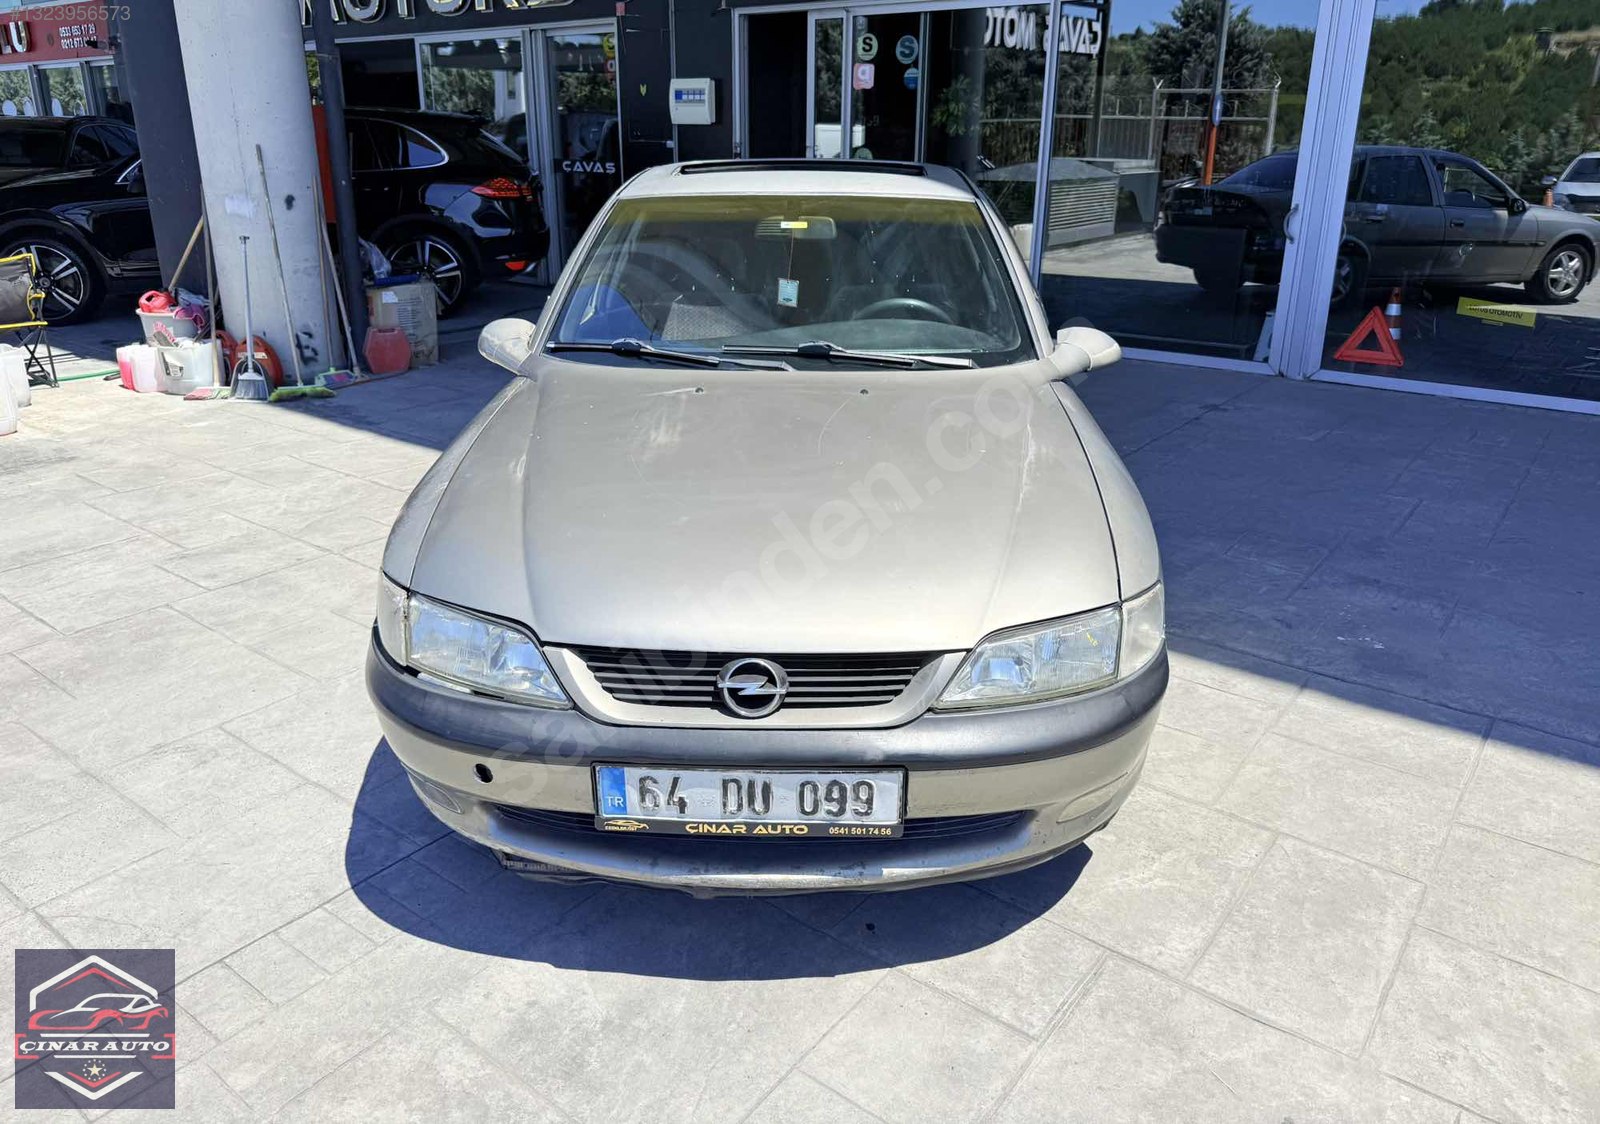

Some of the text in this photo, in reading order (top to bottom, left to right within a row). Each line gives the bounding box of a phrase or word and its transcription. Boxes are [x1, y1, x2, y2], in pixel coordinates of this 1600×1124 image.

[562, 160, 616, 175] ÇAVAŞ
[608, 775, 877, 818] TR 64 DU 099
[685, 822, 892, 836] ÇINAR AUTO 0541 501 74 56
